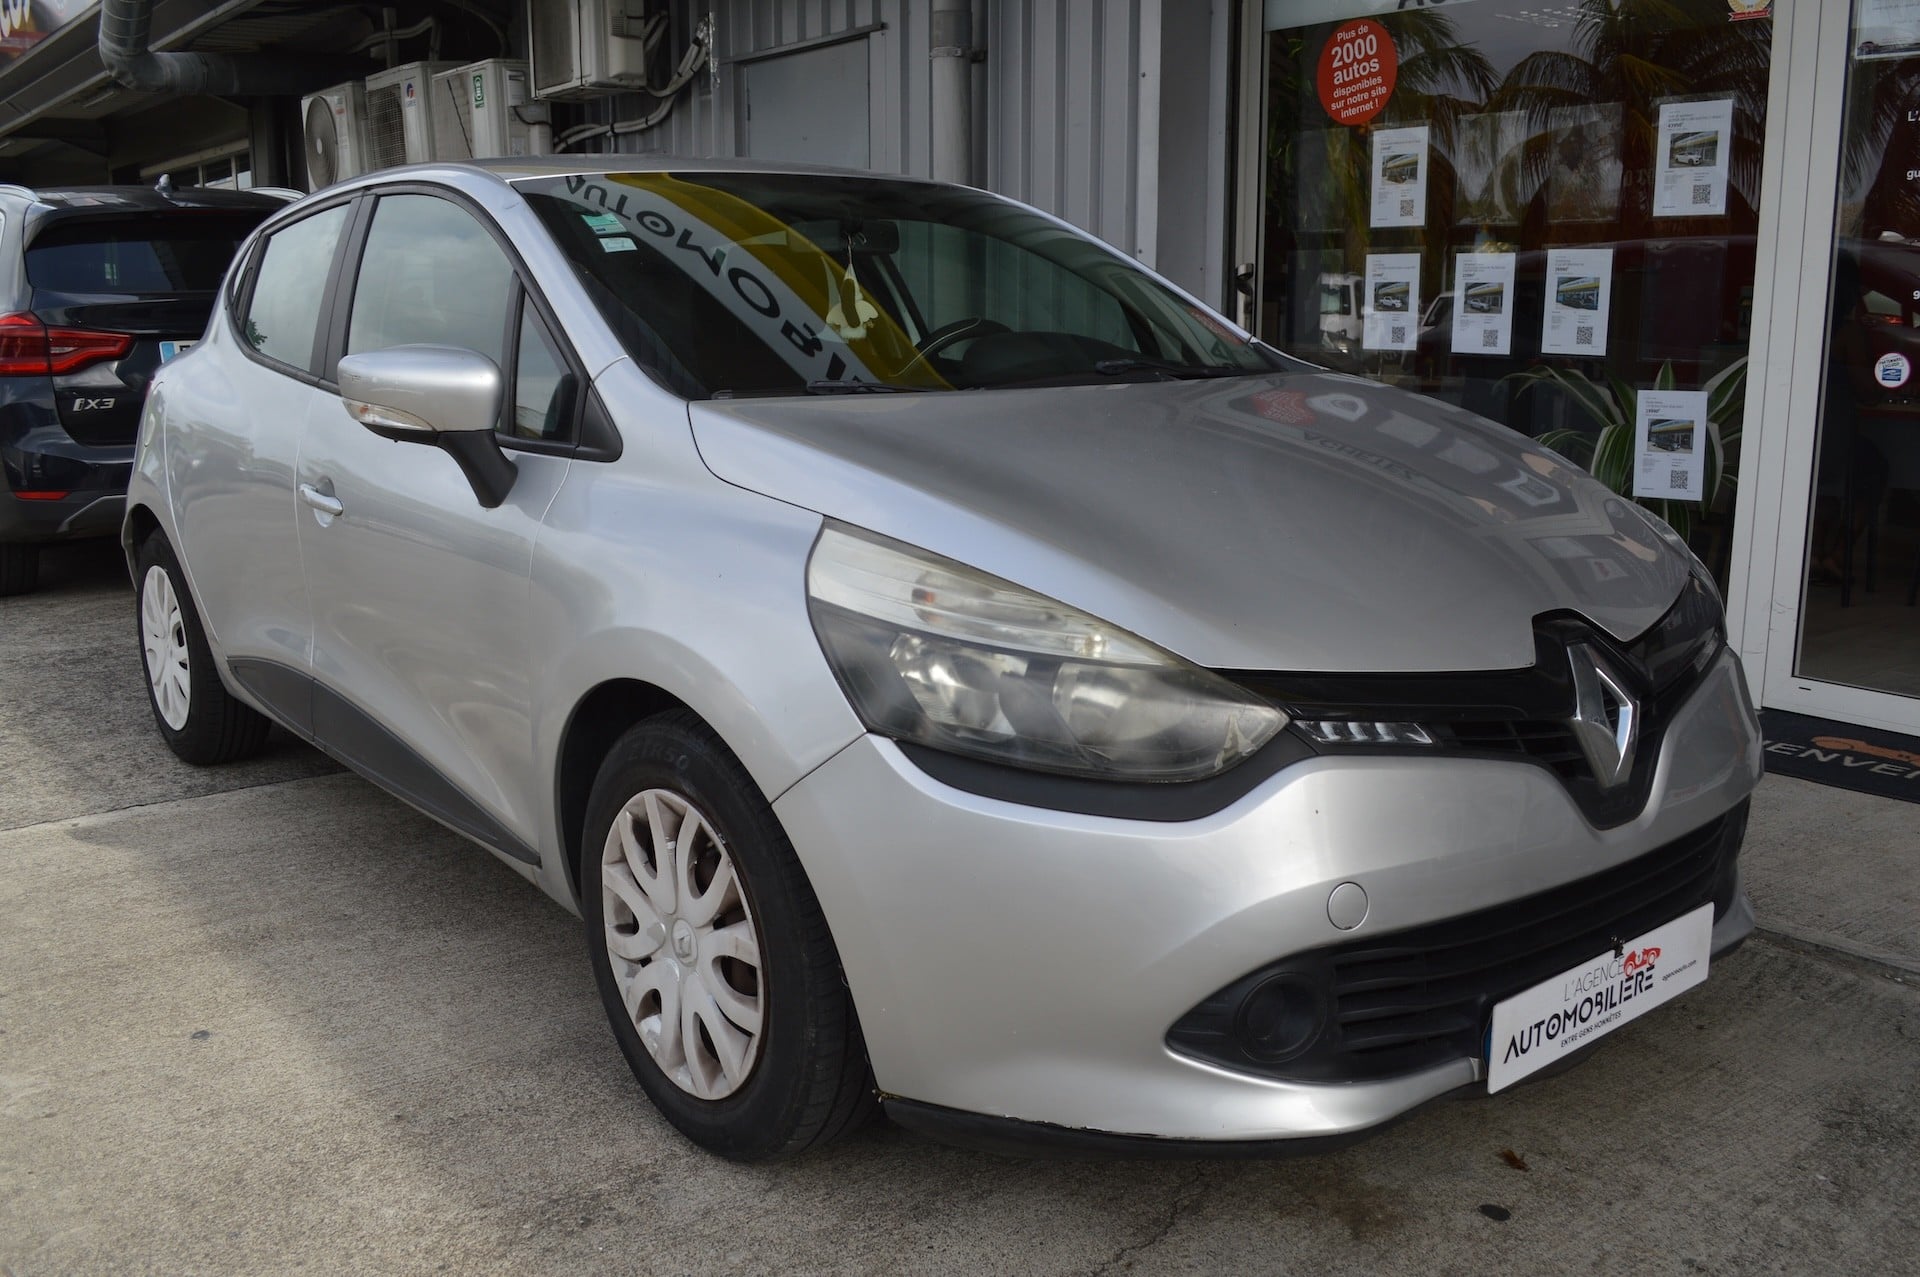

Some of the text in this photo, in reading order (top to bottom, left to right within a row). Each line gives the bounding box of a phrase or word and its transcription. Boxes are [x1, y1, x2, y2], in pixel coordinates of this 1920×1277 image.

[1337, 25, 1369, 42] Plus de
[1331, 34, 1377, 68] 2000
[1333, 58, 1380, 85] autos
[1331, 85, 1387, 110] sur notre site
[1333, 76, 1383, 98] disponibles
[1341, 100, 1374, 119] internet
[1564, 955, 1625, 1002] L'AGENCE
[1561, 1032, 1578, 1048] ENTRE
[1579, 1024, 1594, 1038] GENS
